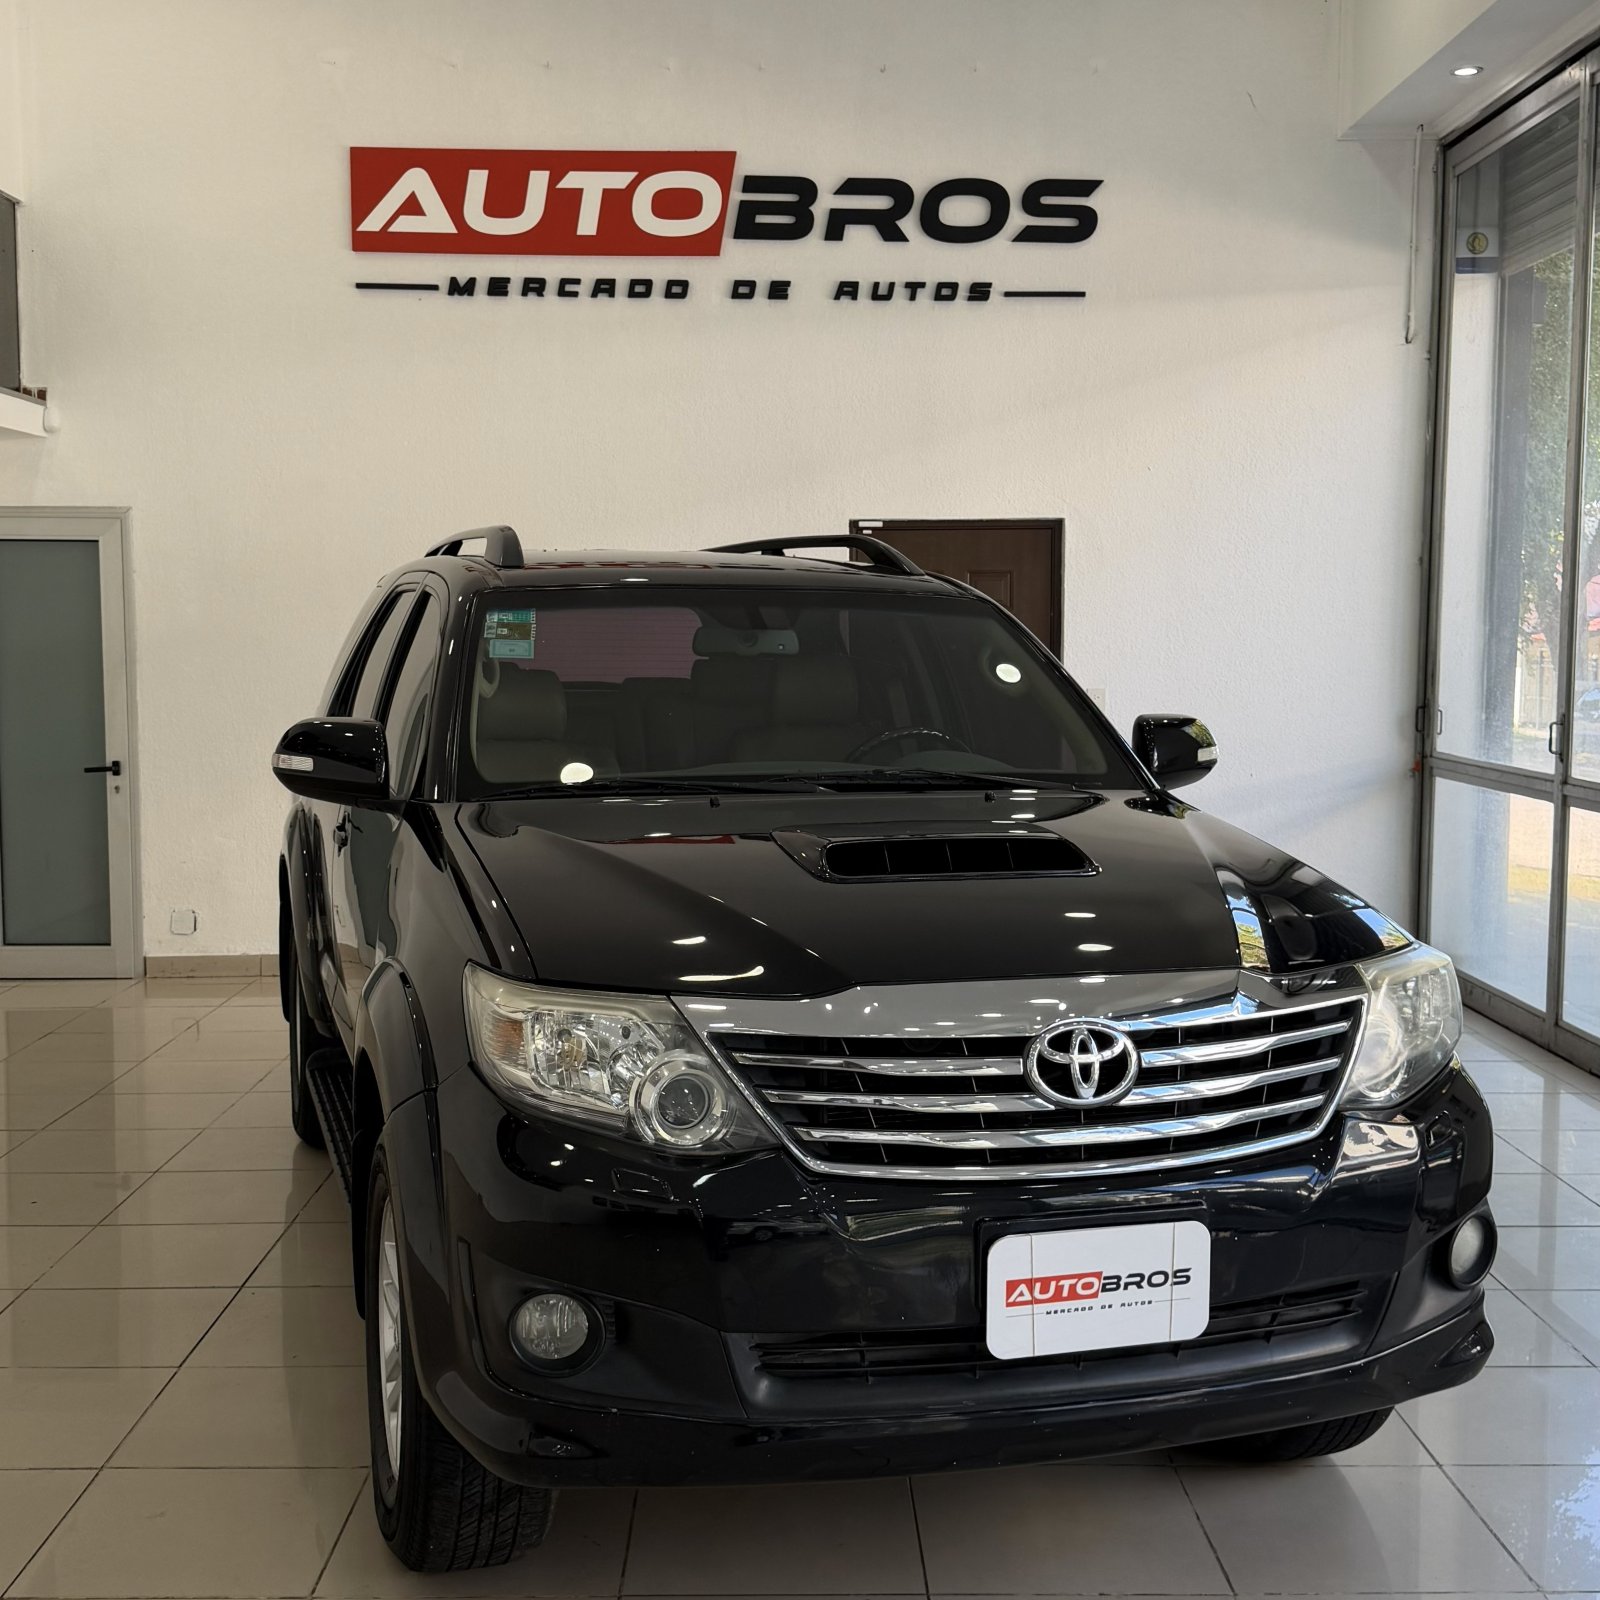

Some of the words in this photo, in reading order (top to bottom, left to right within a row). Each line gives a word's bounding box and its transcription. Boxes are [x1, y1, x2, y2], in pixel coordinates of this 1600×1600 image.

[447, 276, 690, 300] MERCADO
[731, 279, 792, 301] DE
[833, 280, 993, 302] AUTOS
[1045, 1305, 1094, 1315] MERCADO
[1120, 1299, 1153, 1308] AUTOS
